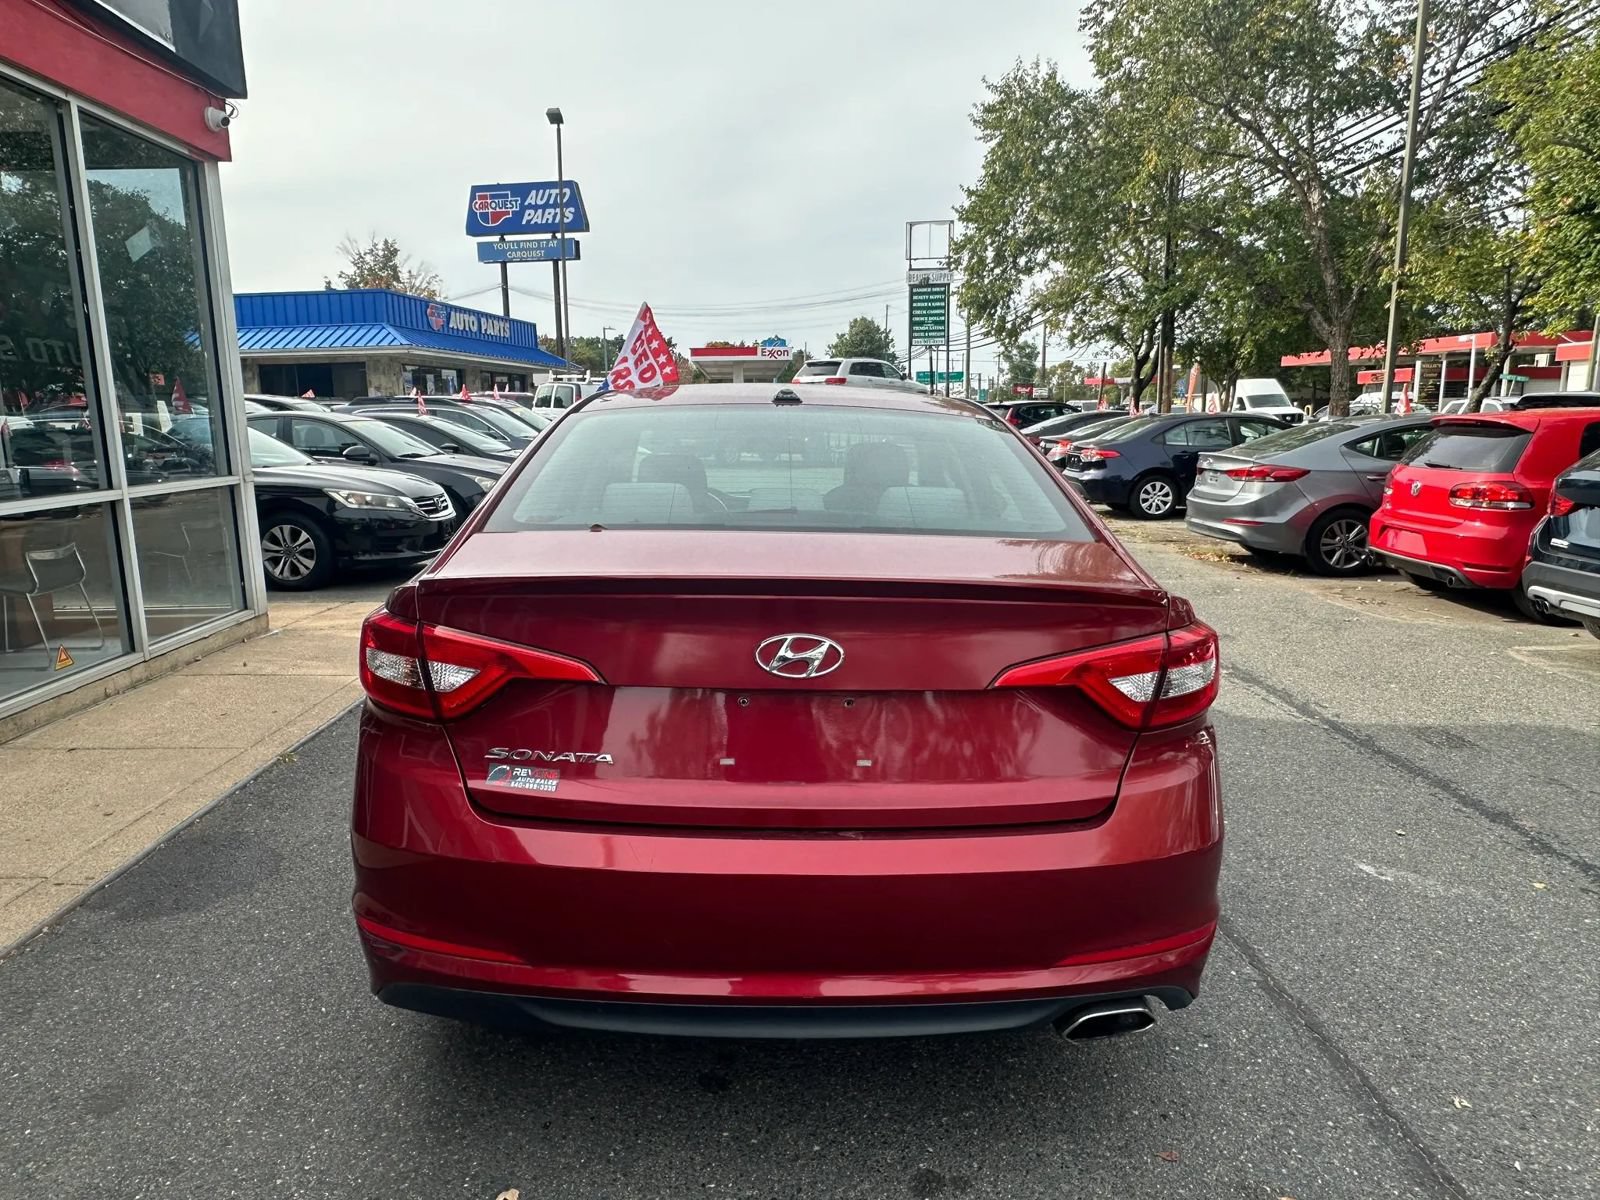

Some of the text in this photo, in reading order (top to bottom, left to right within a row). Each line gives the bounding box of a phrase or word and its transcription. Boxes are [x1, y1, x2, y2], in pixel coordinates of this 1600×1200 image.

[525, 188, 571, 206] AUTO
[473, 199, 520, 211] CARQUEST
[522, 207, 575, 225] PARTS
[493, 241, 518, 250] YOU'LL
[520, 241, 538, 249] FIND
[540, 240, 547, 248] IT
[506, 250, 545, 259] CARQUEST
[449, 312, 478, 333] AUTO
[480, 317, 510, 338] PARTS
[760, 347, 789, 359] Exxon
[484, 747, 614, 764] SONATA
